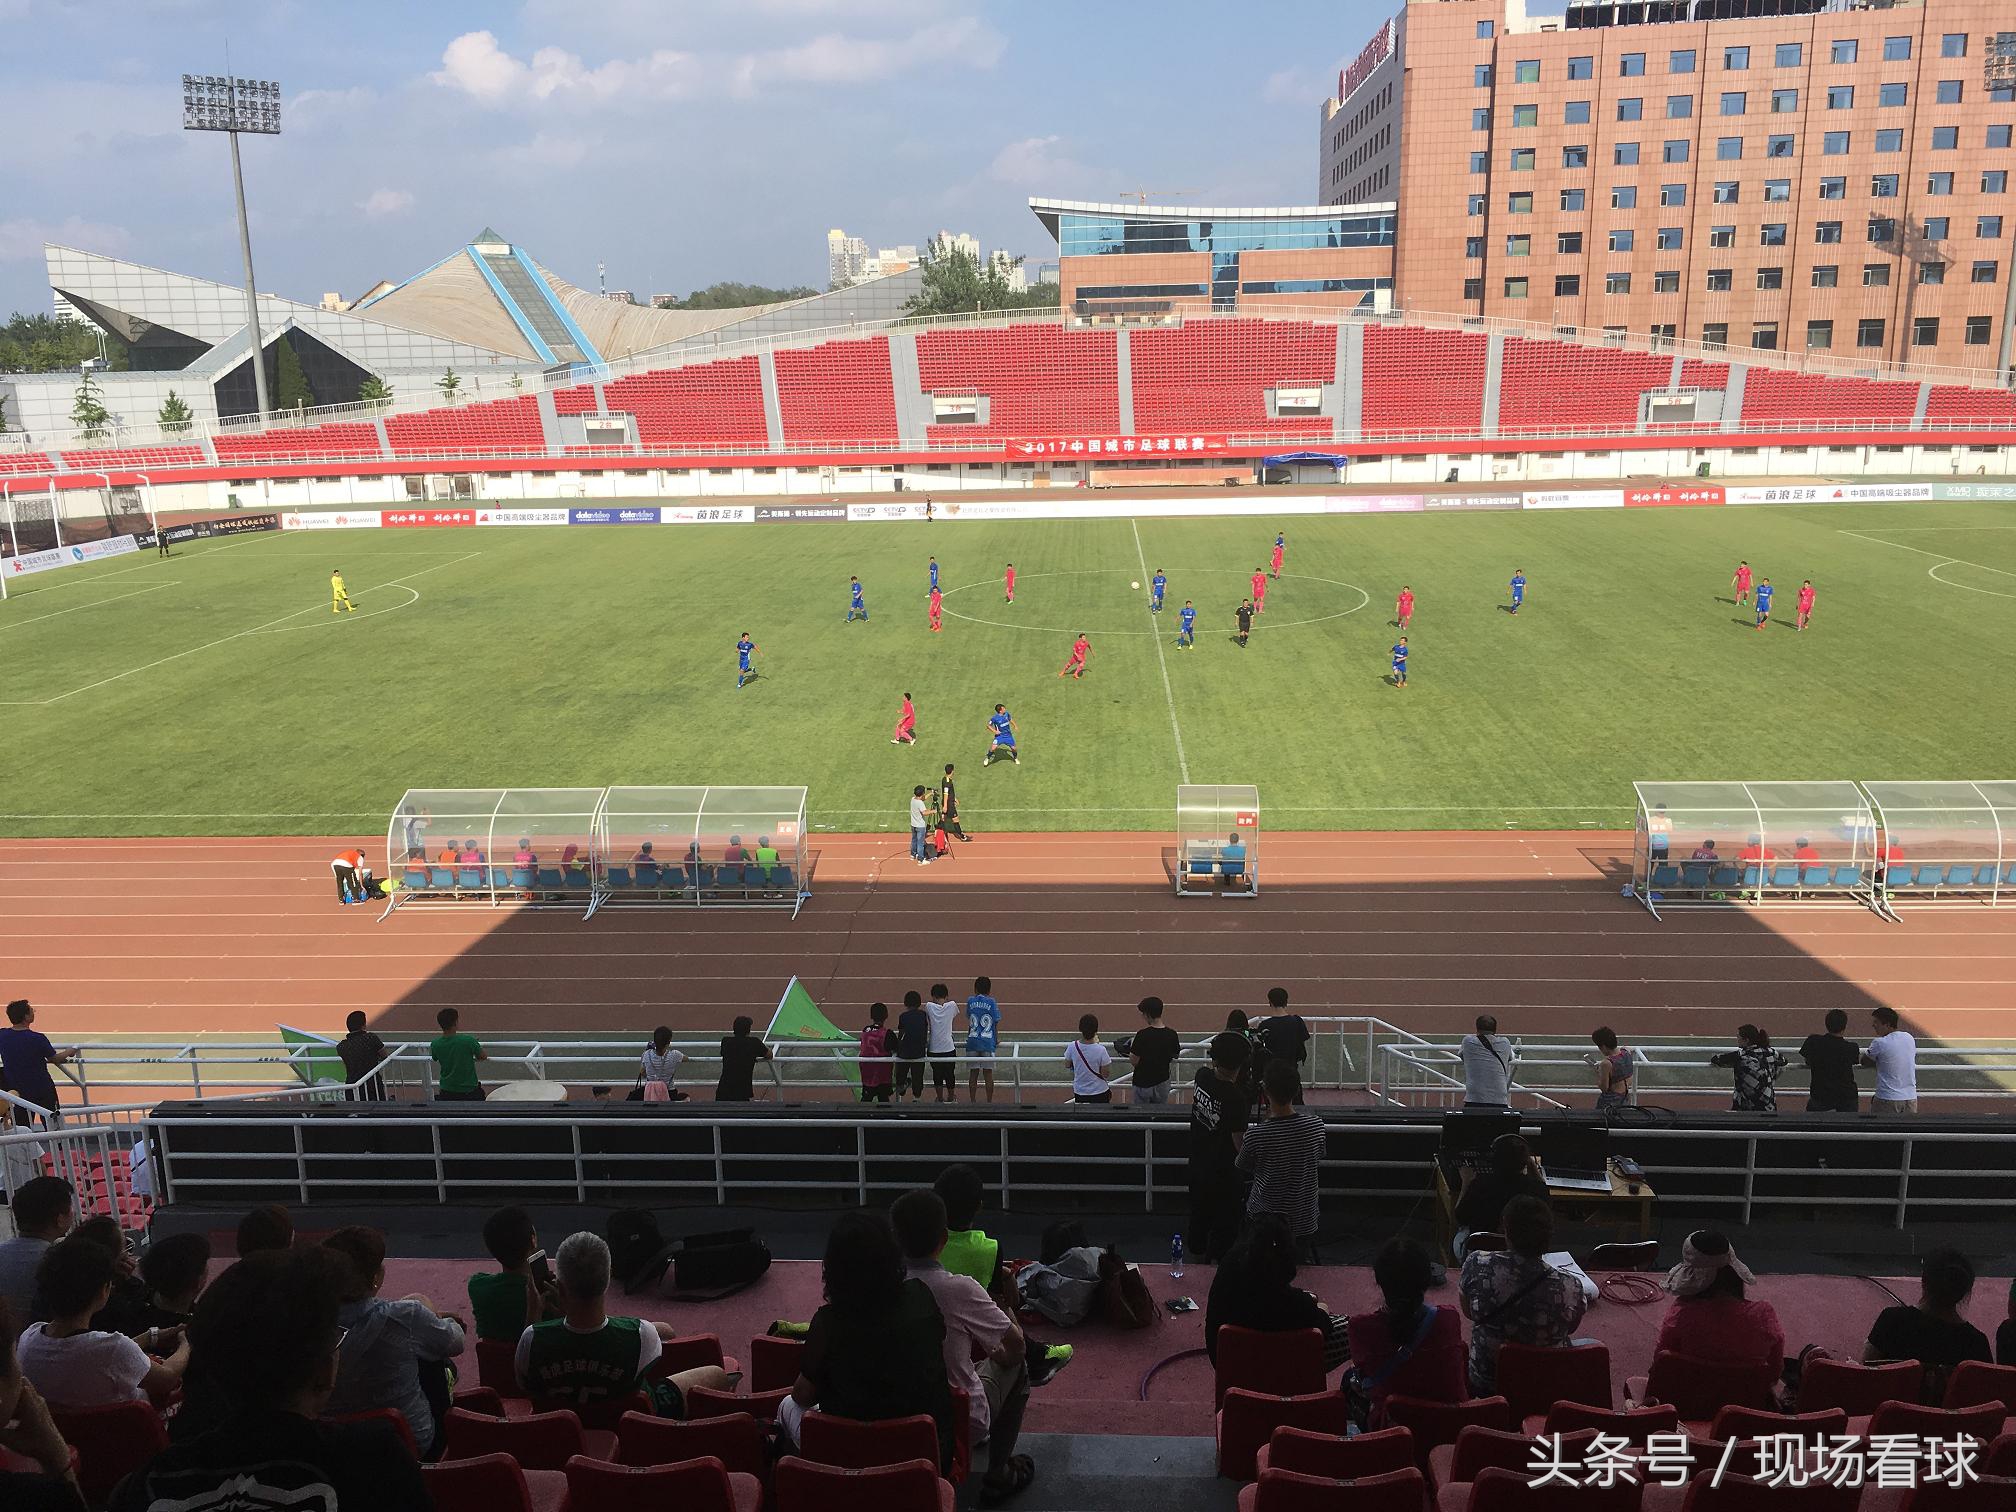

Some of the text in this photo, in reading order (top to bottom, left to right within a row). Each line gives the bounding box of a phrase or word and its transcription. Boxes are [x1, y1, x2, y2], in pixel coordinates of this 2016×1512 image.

[1024, 437, 1205, 454] 2017中国城市足球联赛
[1765, 489, 1816, 500] 茵浪足球
[1850, 488, 1930, 497] 中国高端吸尘器品牌
[495, 513, 566, 521] 中国高端吸尘器品牌
[575, 510, 611, 519] datavideo
[619, 509, 655, 519] datavideo
[696, 509, 743, 520] 茵浪足球
